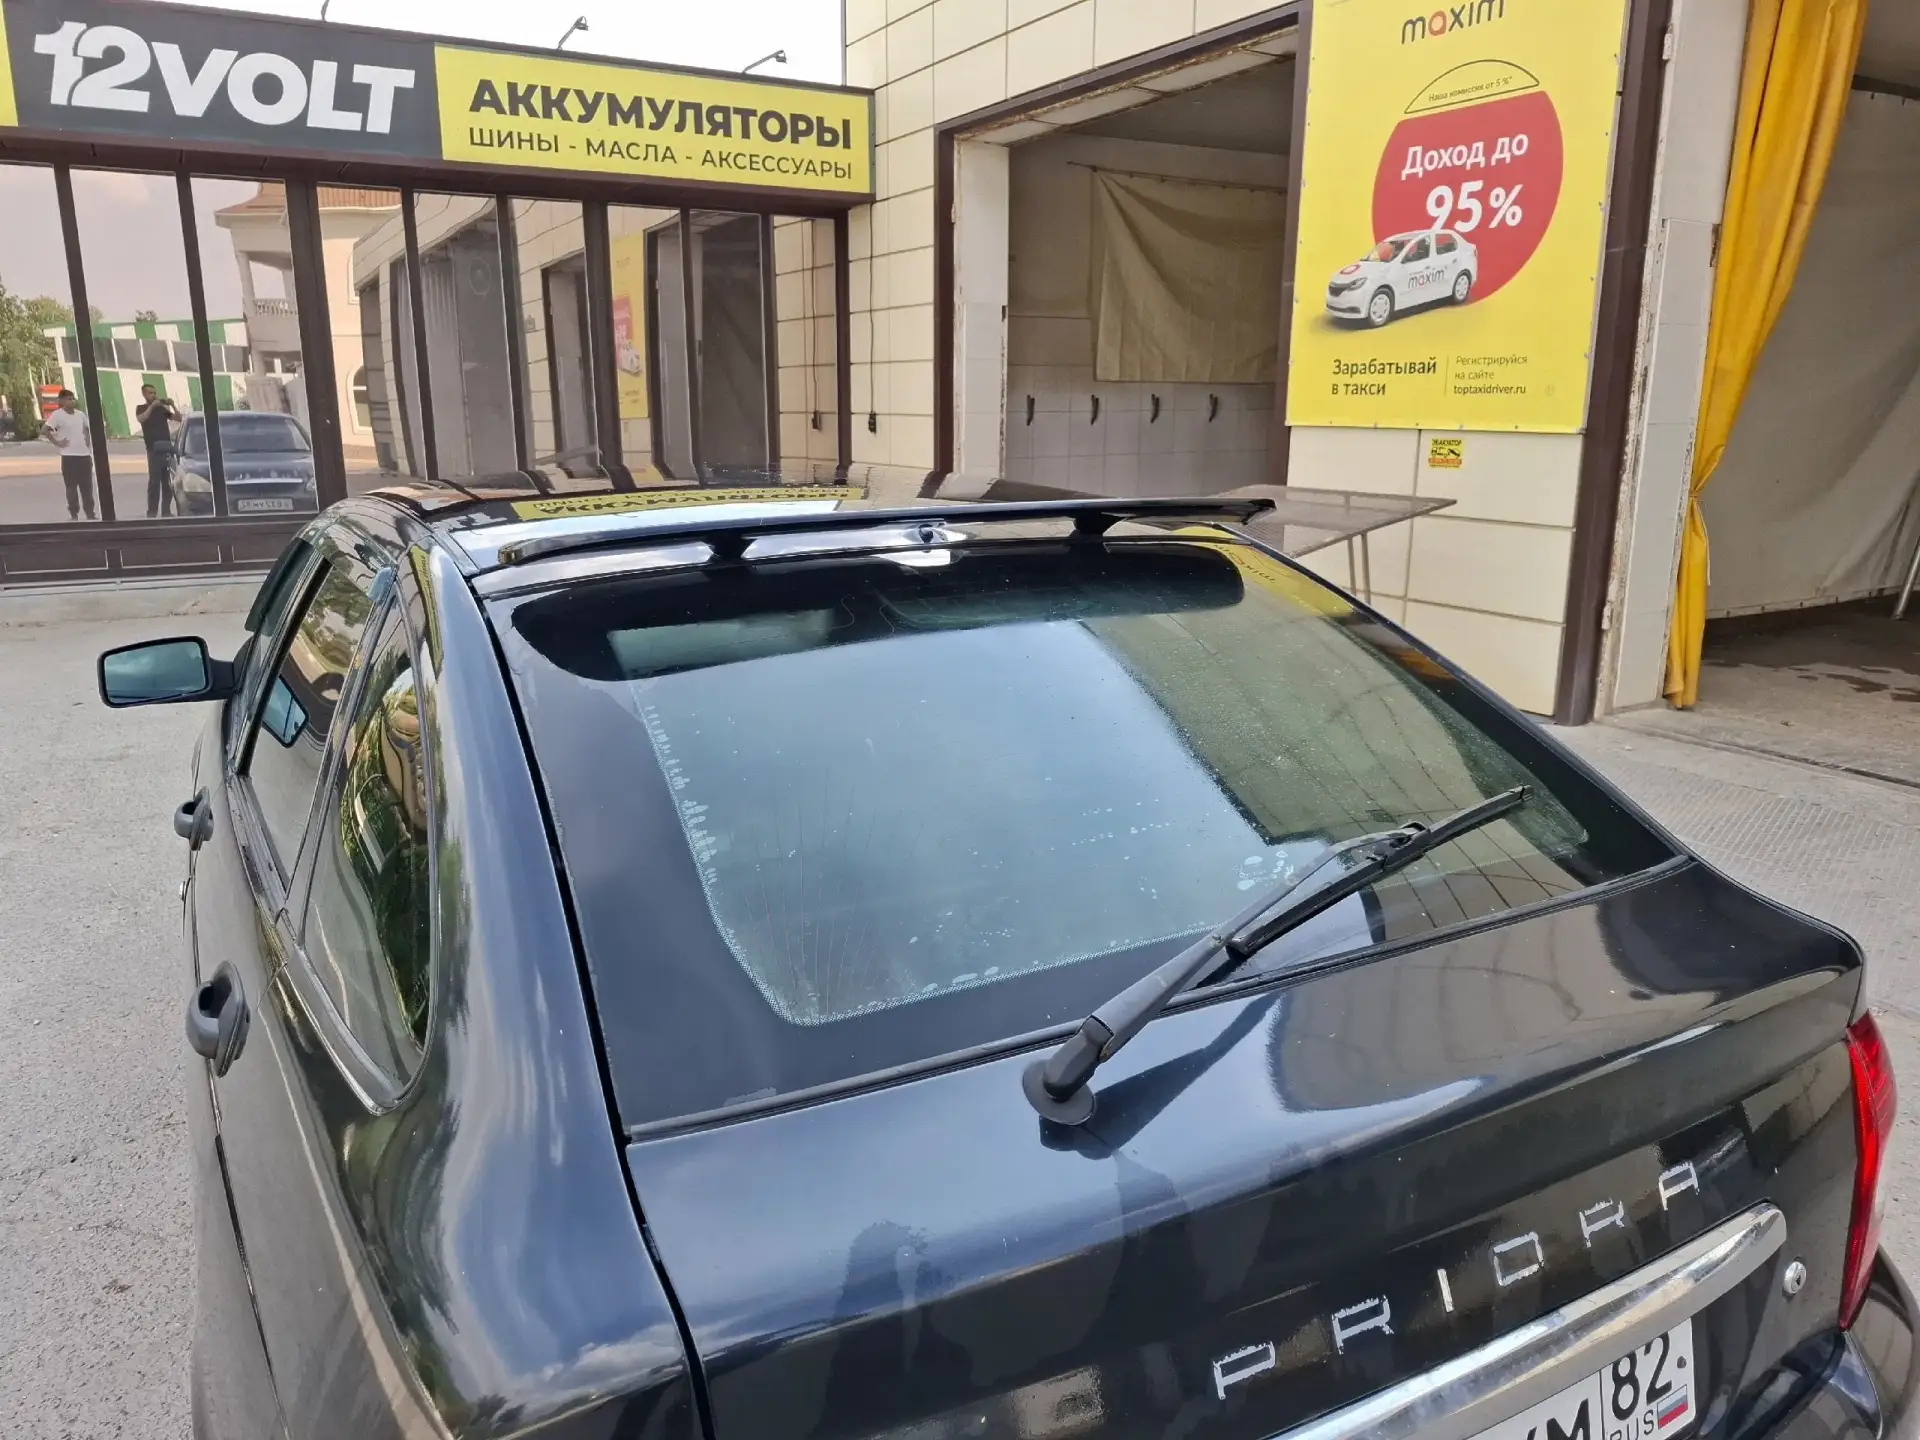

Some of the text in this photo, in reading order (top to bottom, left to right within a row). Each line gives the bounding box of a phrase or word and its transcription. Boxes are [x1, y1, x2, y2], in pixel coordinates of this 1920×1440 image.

[1401, 0, 1505, 44] maxim
[33, 20, 415, 134] 12VOLT
[468, 78, 852, 150] АККУМУЛЯТОРЫ
[468, 126, 559, 153] ШИНЫ
[586, 137, 678, 164] МАСЛА
[700, 149, 852, 180] АКСЕССУАРЫ
[1401, 133, 1529, 181] Доход до
[1408, 267, 1445, 289] maxim
[1332, 356, 1437, 378] Зарабатывай
[1454, 369, 1495, 380] на сайте
[1456, 354, 1528, 366] Регистрируйся
[1331, 383, 1386, 395] в такси
[1453, 383, 1527, 395] toptaxidriver.ru
[1212, 1161, 1699, 1400] PRIORA
[1611, 1330, 1673, 1421] 82
